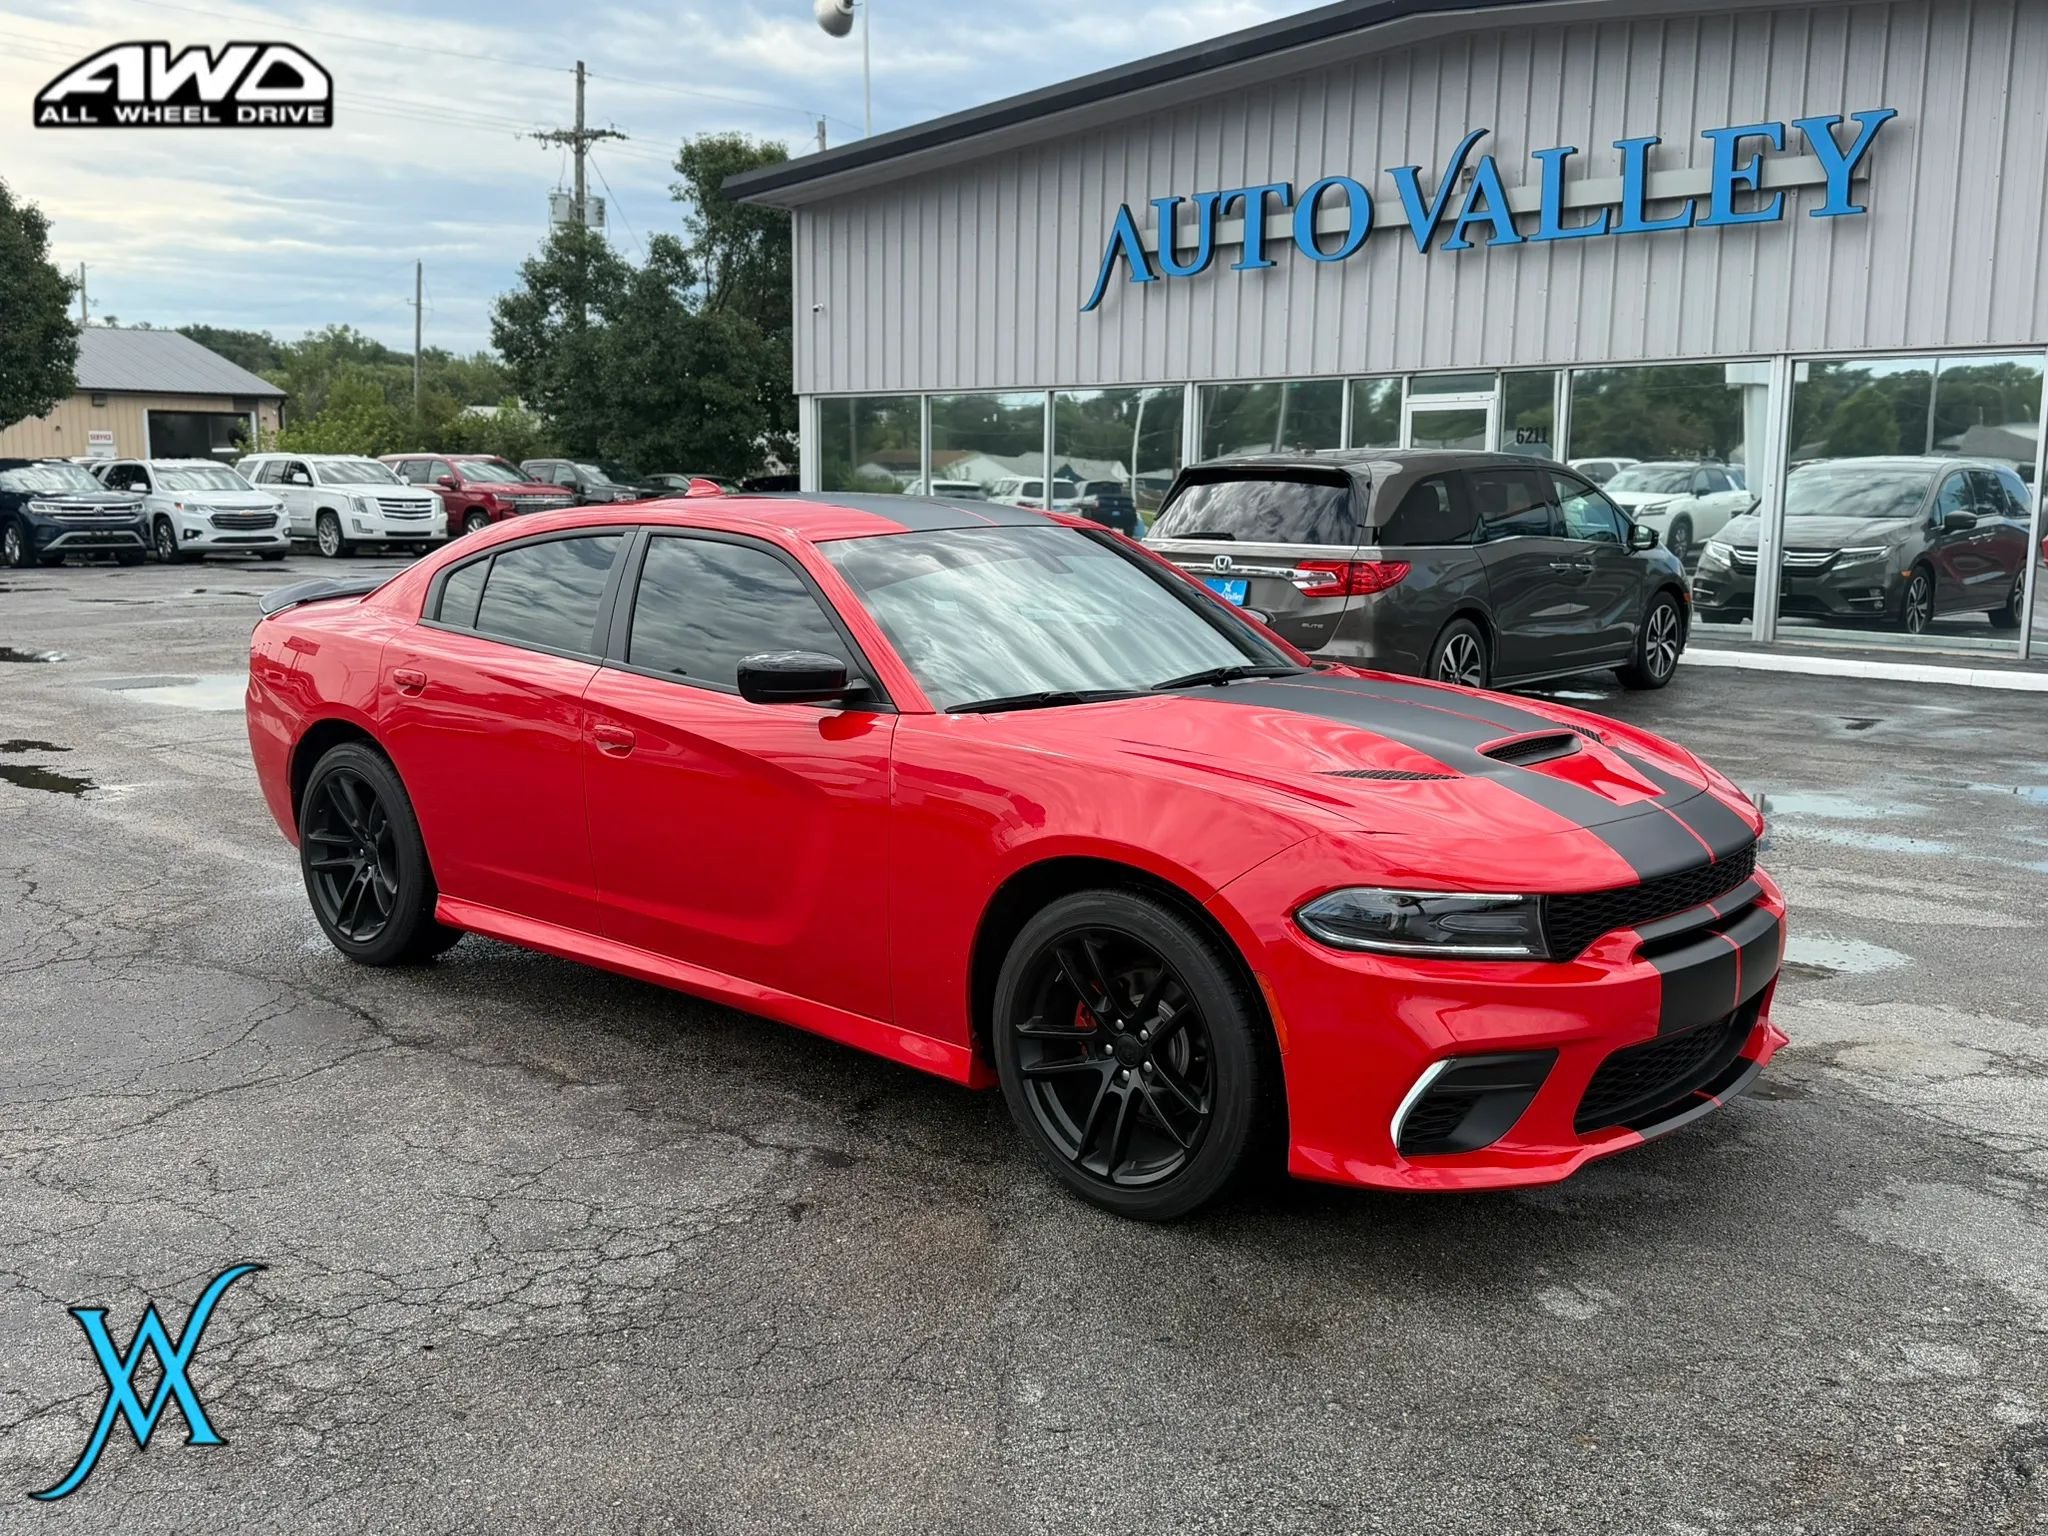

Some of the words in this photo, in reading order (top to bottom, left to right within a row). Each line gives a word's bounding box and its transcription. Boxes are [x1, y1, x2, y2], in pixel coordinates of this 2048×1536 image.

[1080, 175, 1375, 312] AUTO
[1385, 107, 1898, 254] VALLEY
[1516, 427, 1548, 445] 6211
